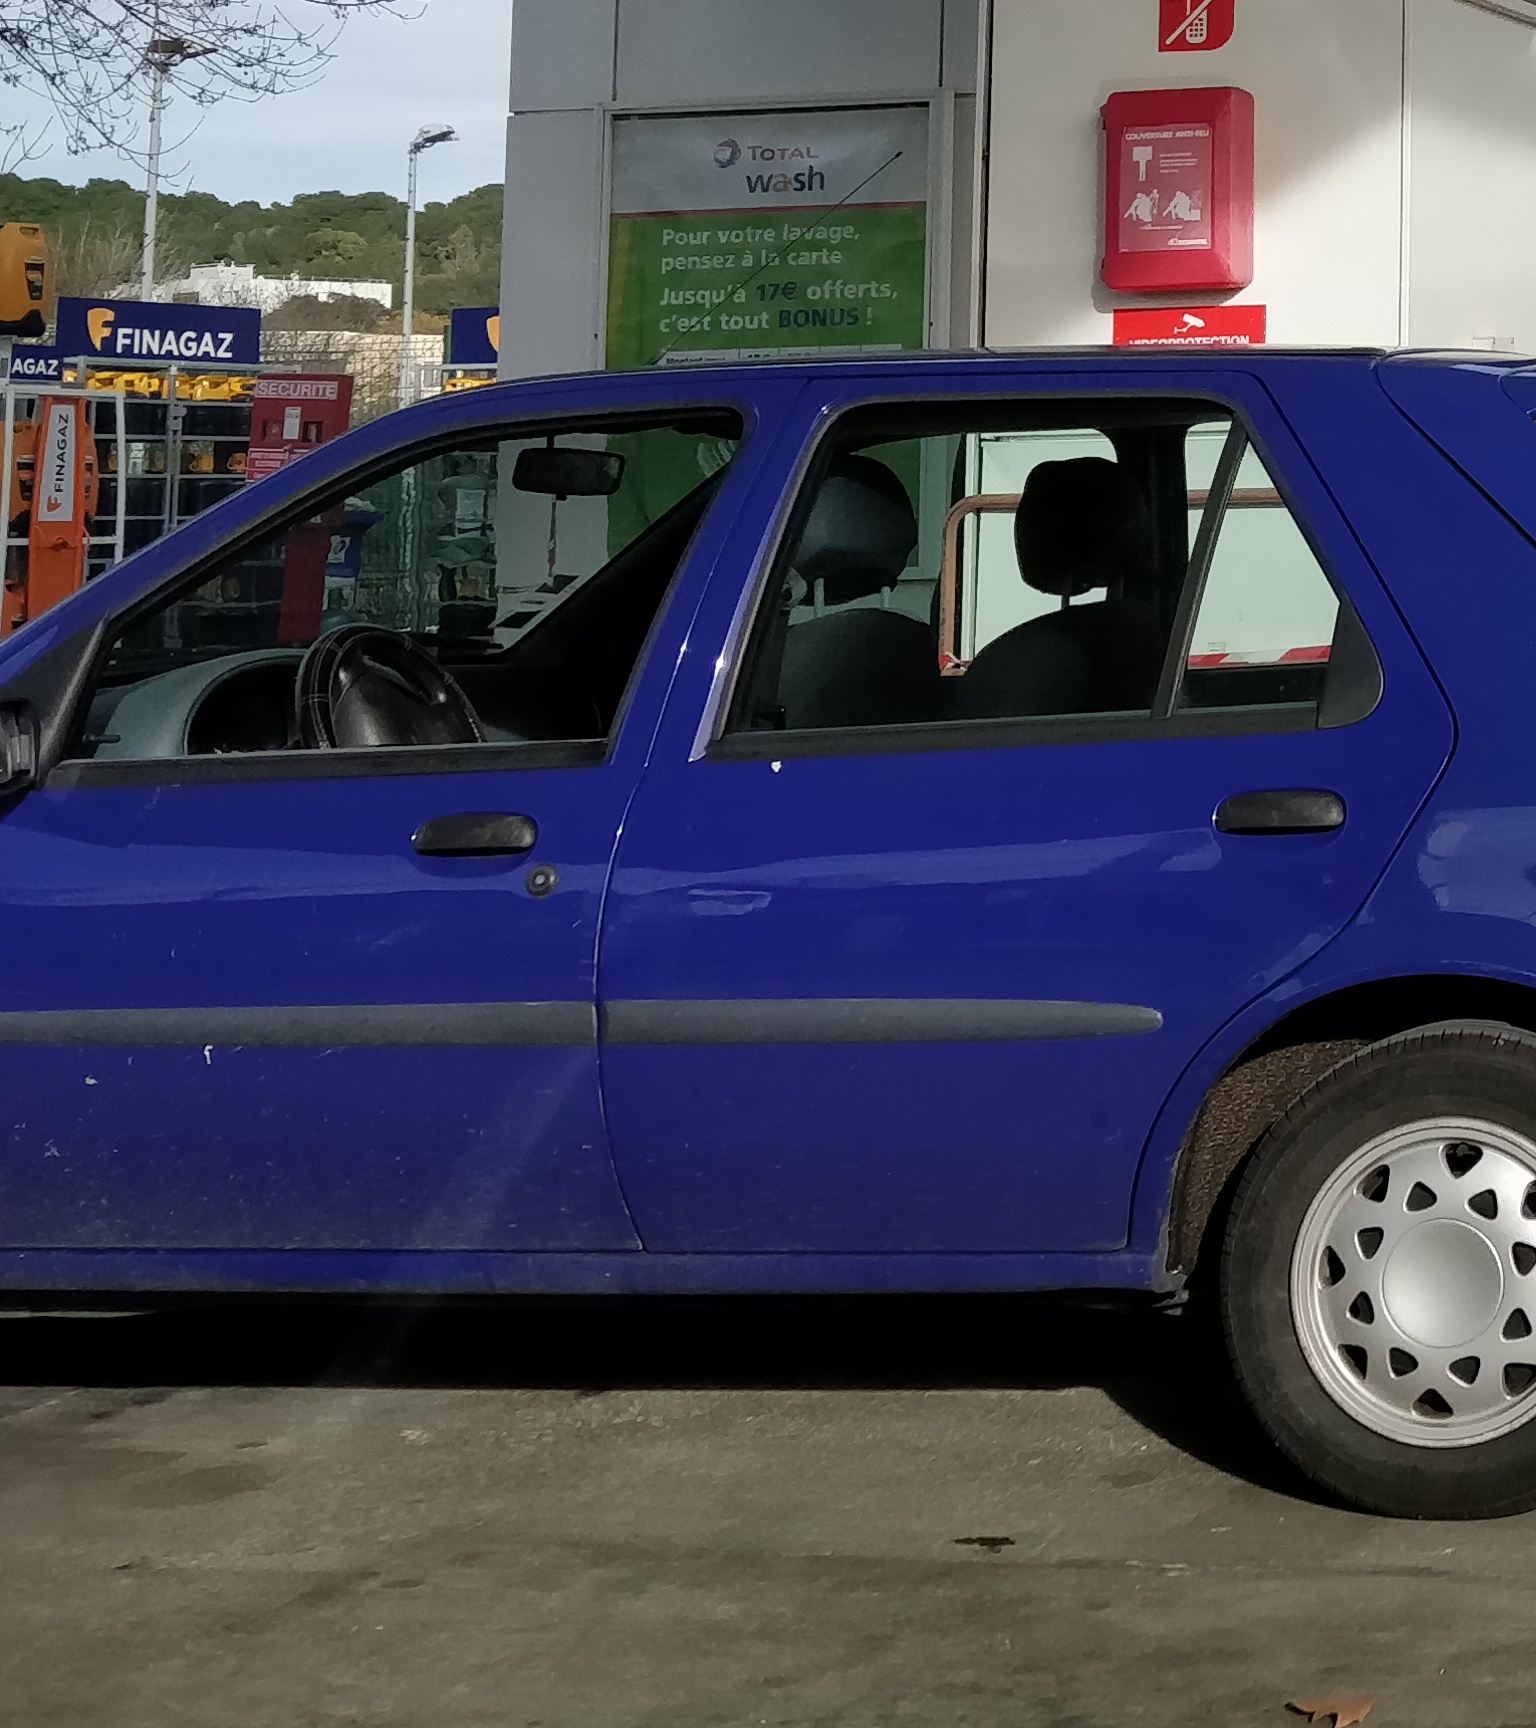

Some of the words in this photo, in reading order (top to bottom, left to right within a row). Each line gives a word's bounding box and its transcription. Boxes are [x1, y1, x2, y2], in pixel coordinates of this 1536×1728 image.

[746, 145, 820, 162] TOTAL
[745, 165, 826, 194] wash
[662, 228, 711, 246] Pour
[718, 226, 775, 243] votre
[782, 223, 860, 244] lavage,
[661, 251, 736, 275] pensez
[740, 249, 754, 268] à
[761, 249, 780, 266] la
[787, 249, 843, 266] carte
[755, 282, 798, 301] 17€
[806, 279, 899, 301] offerts,
[719, 311, 770, 330] tout
[778, 307, 860, 328] BONUS
[866, 306, 873, 326] !
[115, 327, 234, 358] FINAGAZ
[11, 358, 59, 376] AGAZ
[258, 382, 336, 398] SECURITE
[54, 413, 70, 493] FINAGAZ
